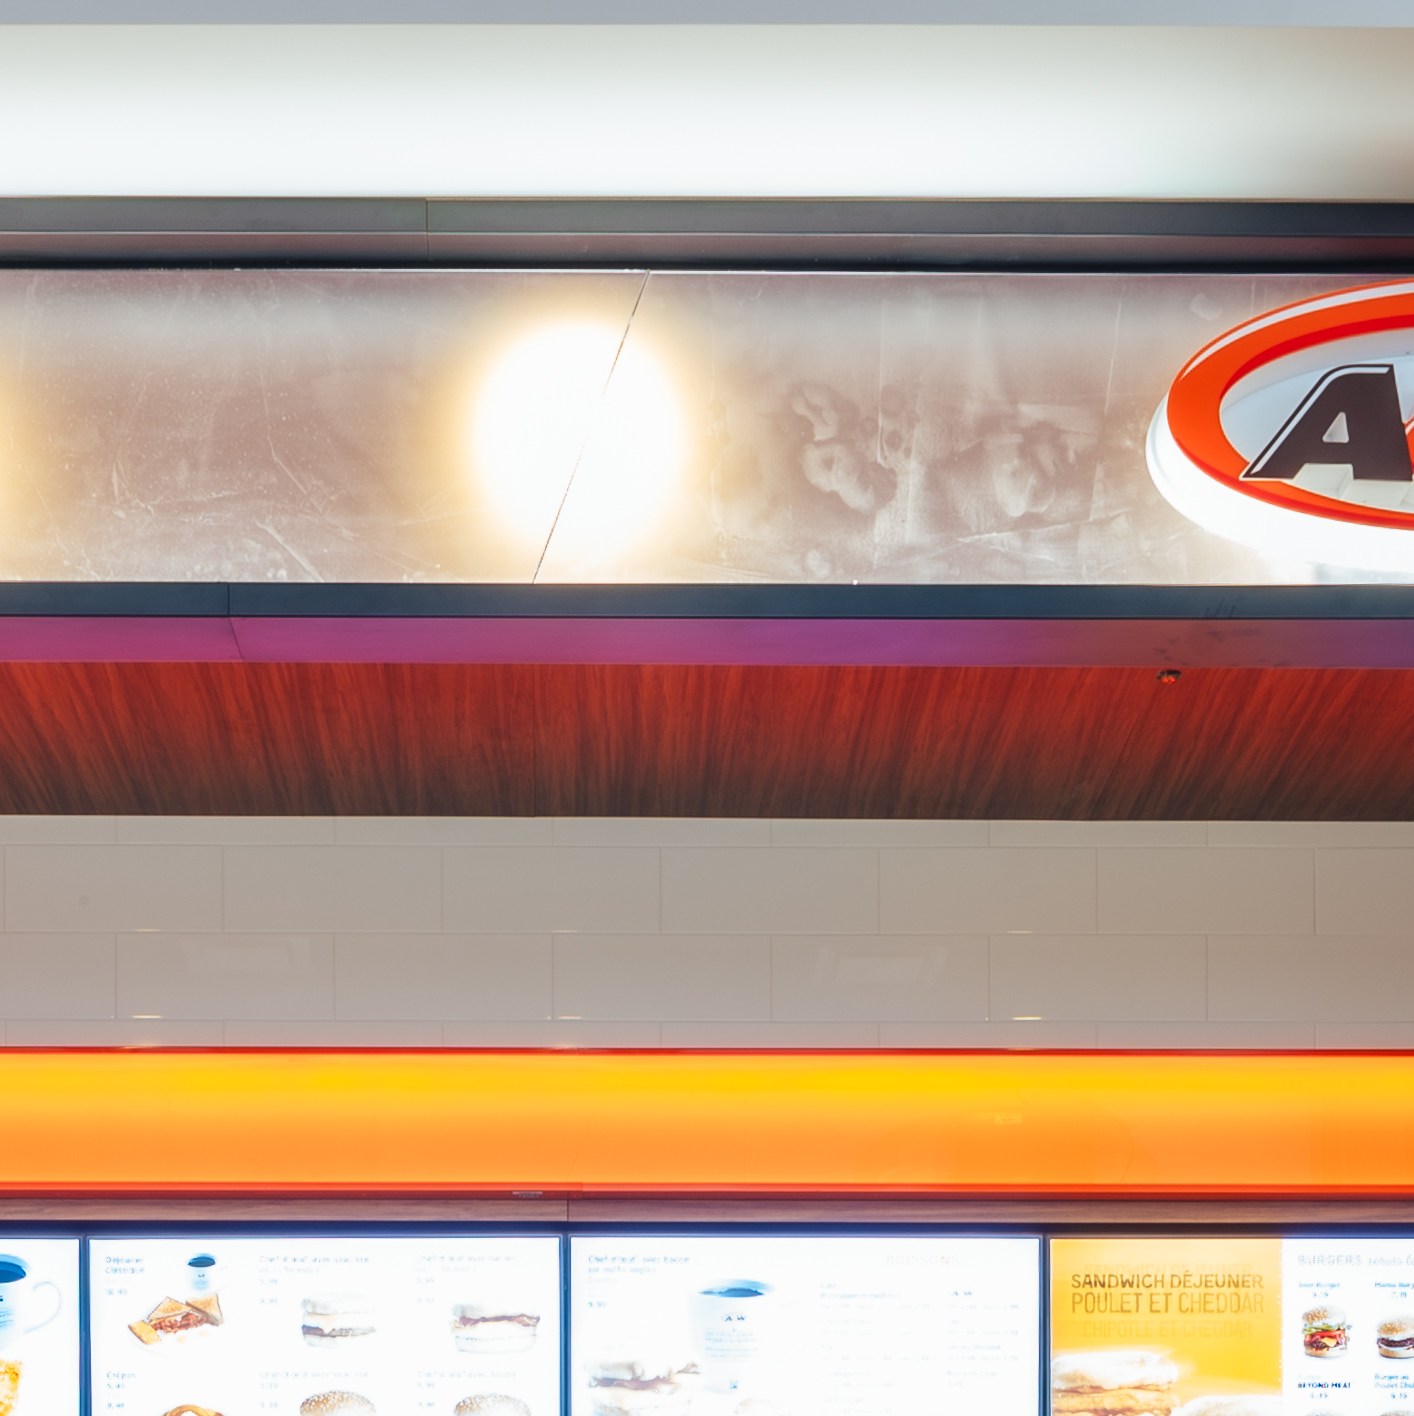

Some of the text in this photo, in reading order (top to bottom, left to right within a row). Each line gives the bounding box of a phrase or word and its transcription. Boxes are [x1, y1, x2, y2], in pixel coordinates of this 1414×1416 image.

[1071, 1270, 1265, 1289] SANDWICH DÉJEUNER
[1072, 1292, 1265, 1314] POULET ET CHEDDAR
